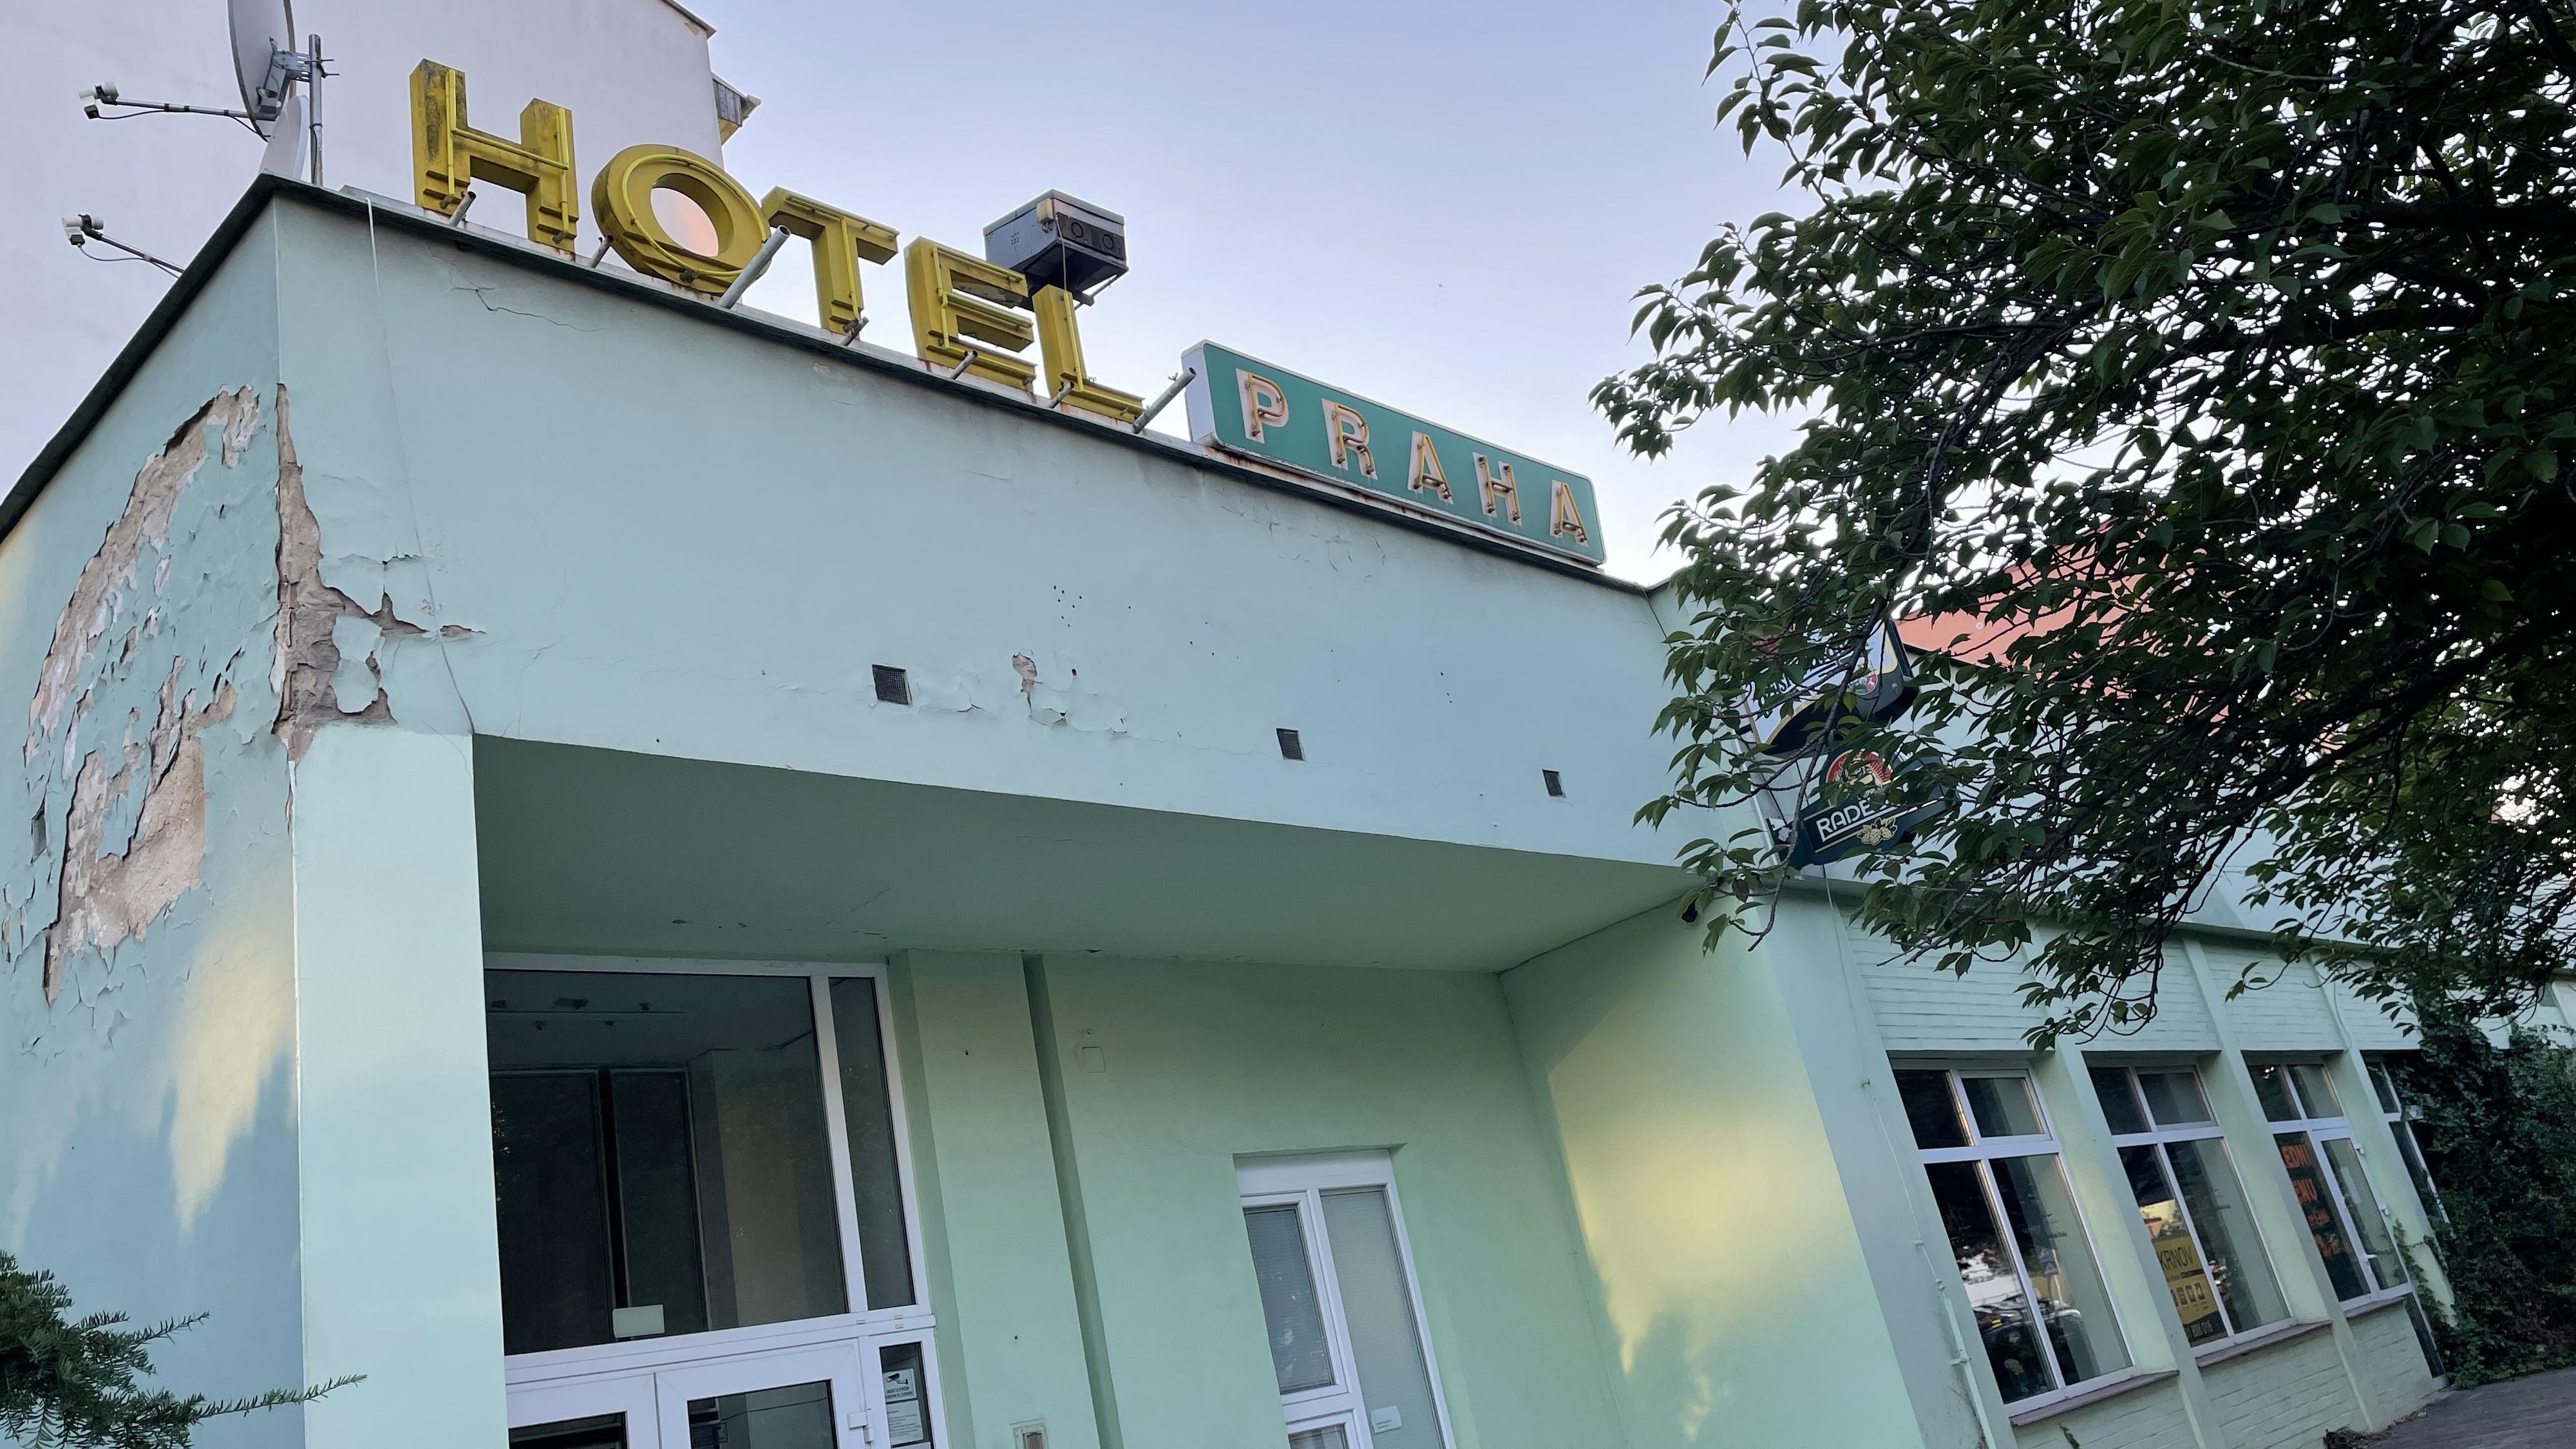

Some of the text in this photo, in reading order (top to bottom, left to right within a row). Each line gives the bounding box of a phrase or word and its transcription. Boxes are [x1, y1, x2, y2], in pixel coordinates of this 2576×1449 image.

[408, 58, 1145, 424] HOTEL
[1235, 367, 1589, 547] PRAHA
[1816, 797, 1887, 842] RADE
